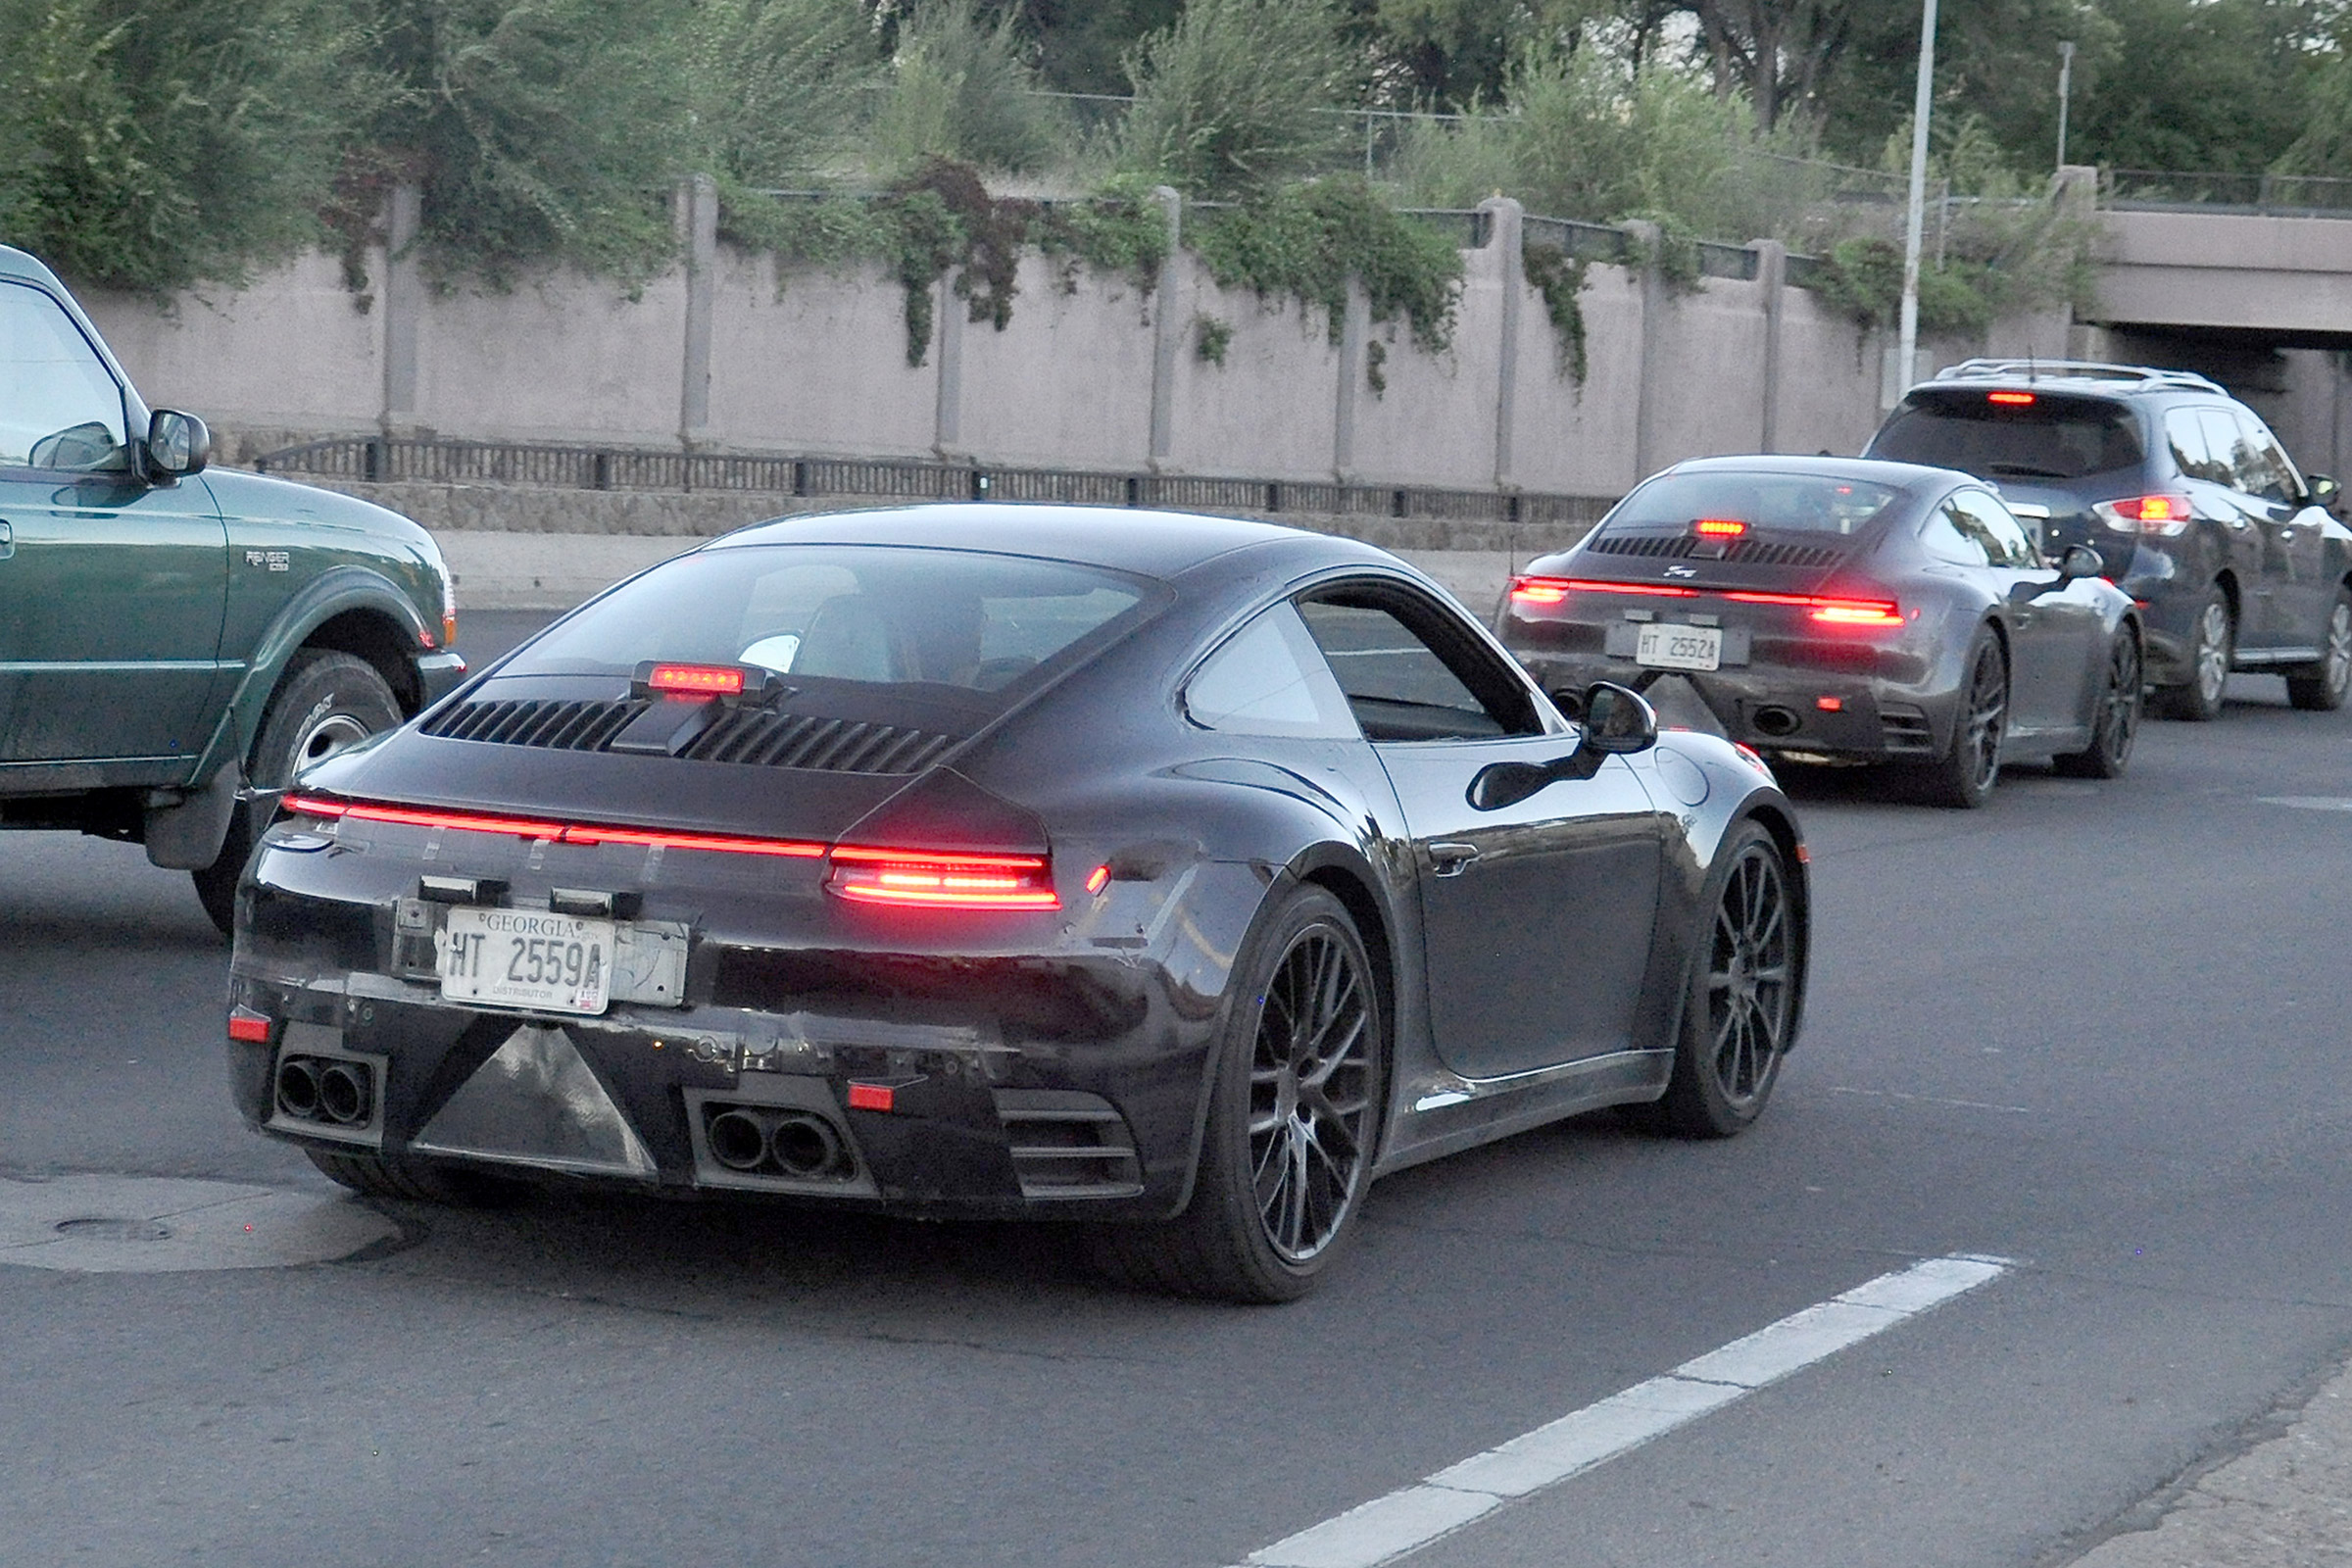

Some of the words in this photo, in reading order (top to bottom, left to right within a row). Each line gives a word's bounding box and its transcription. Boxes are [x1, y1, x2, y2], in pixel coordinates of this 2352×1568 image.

[1670, 636, 1715, 661] 2552A
[450, 932, 486, 977] HT
[508, 937, 601, 989] 2559A
[492, 986, 553, 999] DISTRIBUTOR
